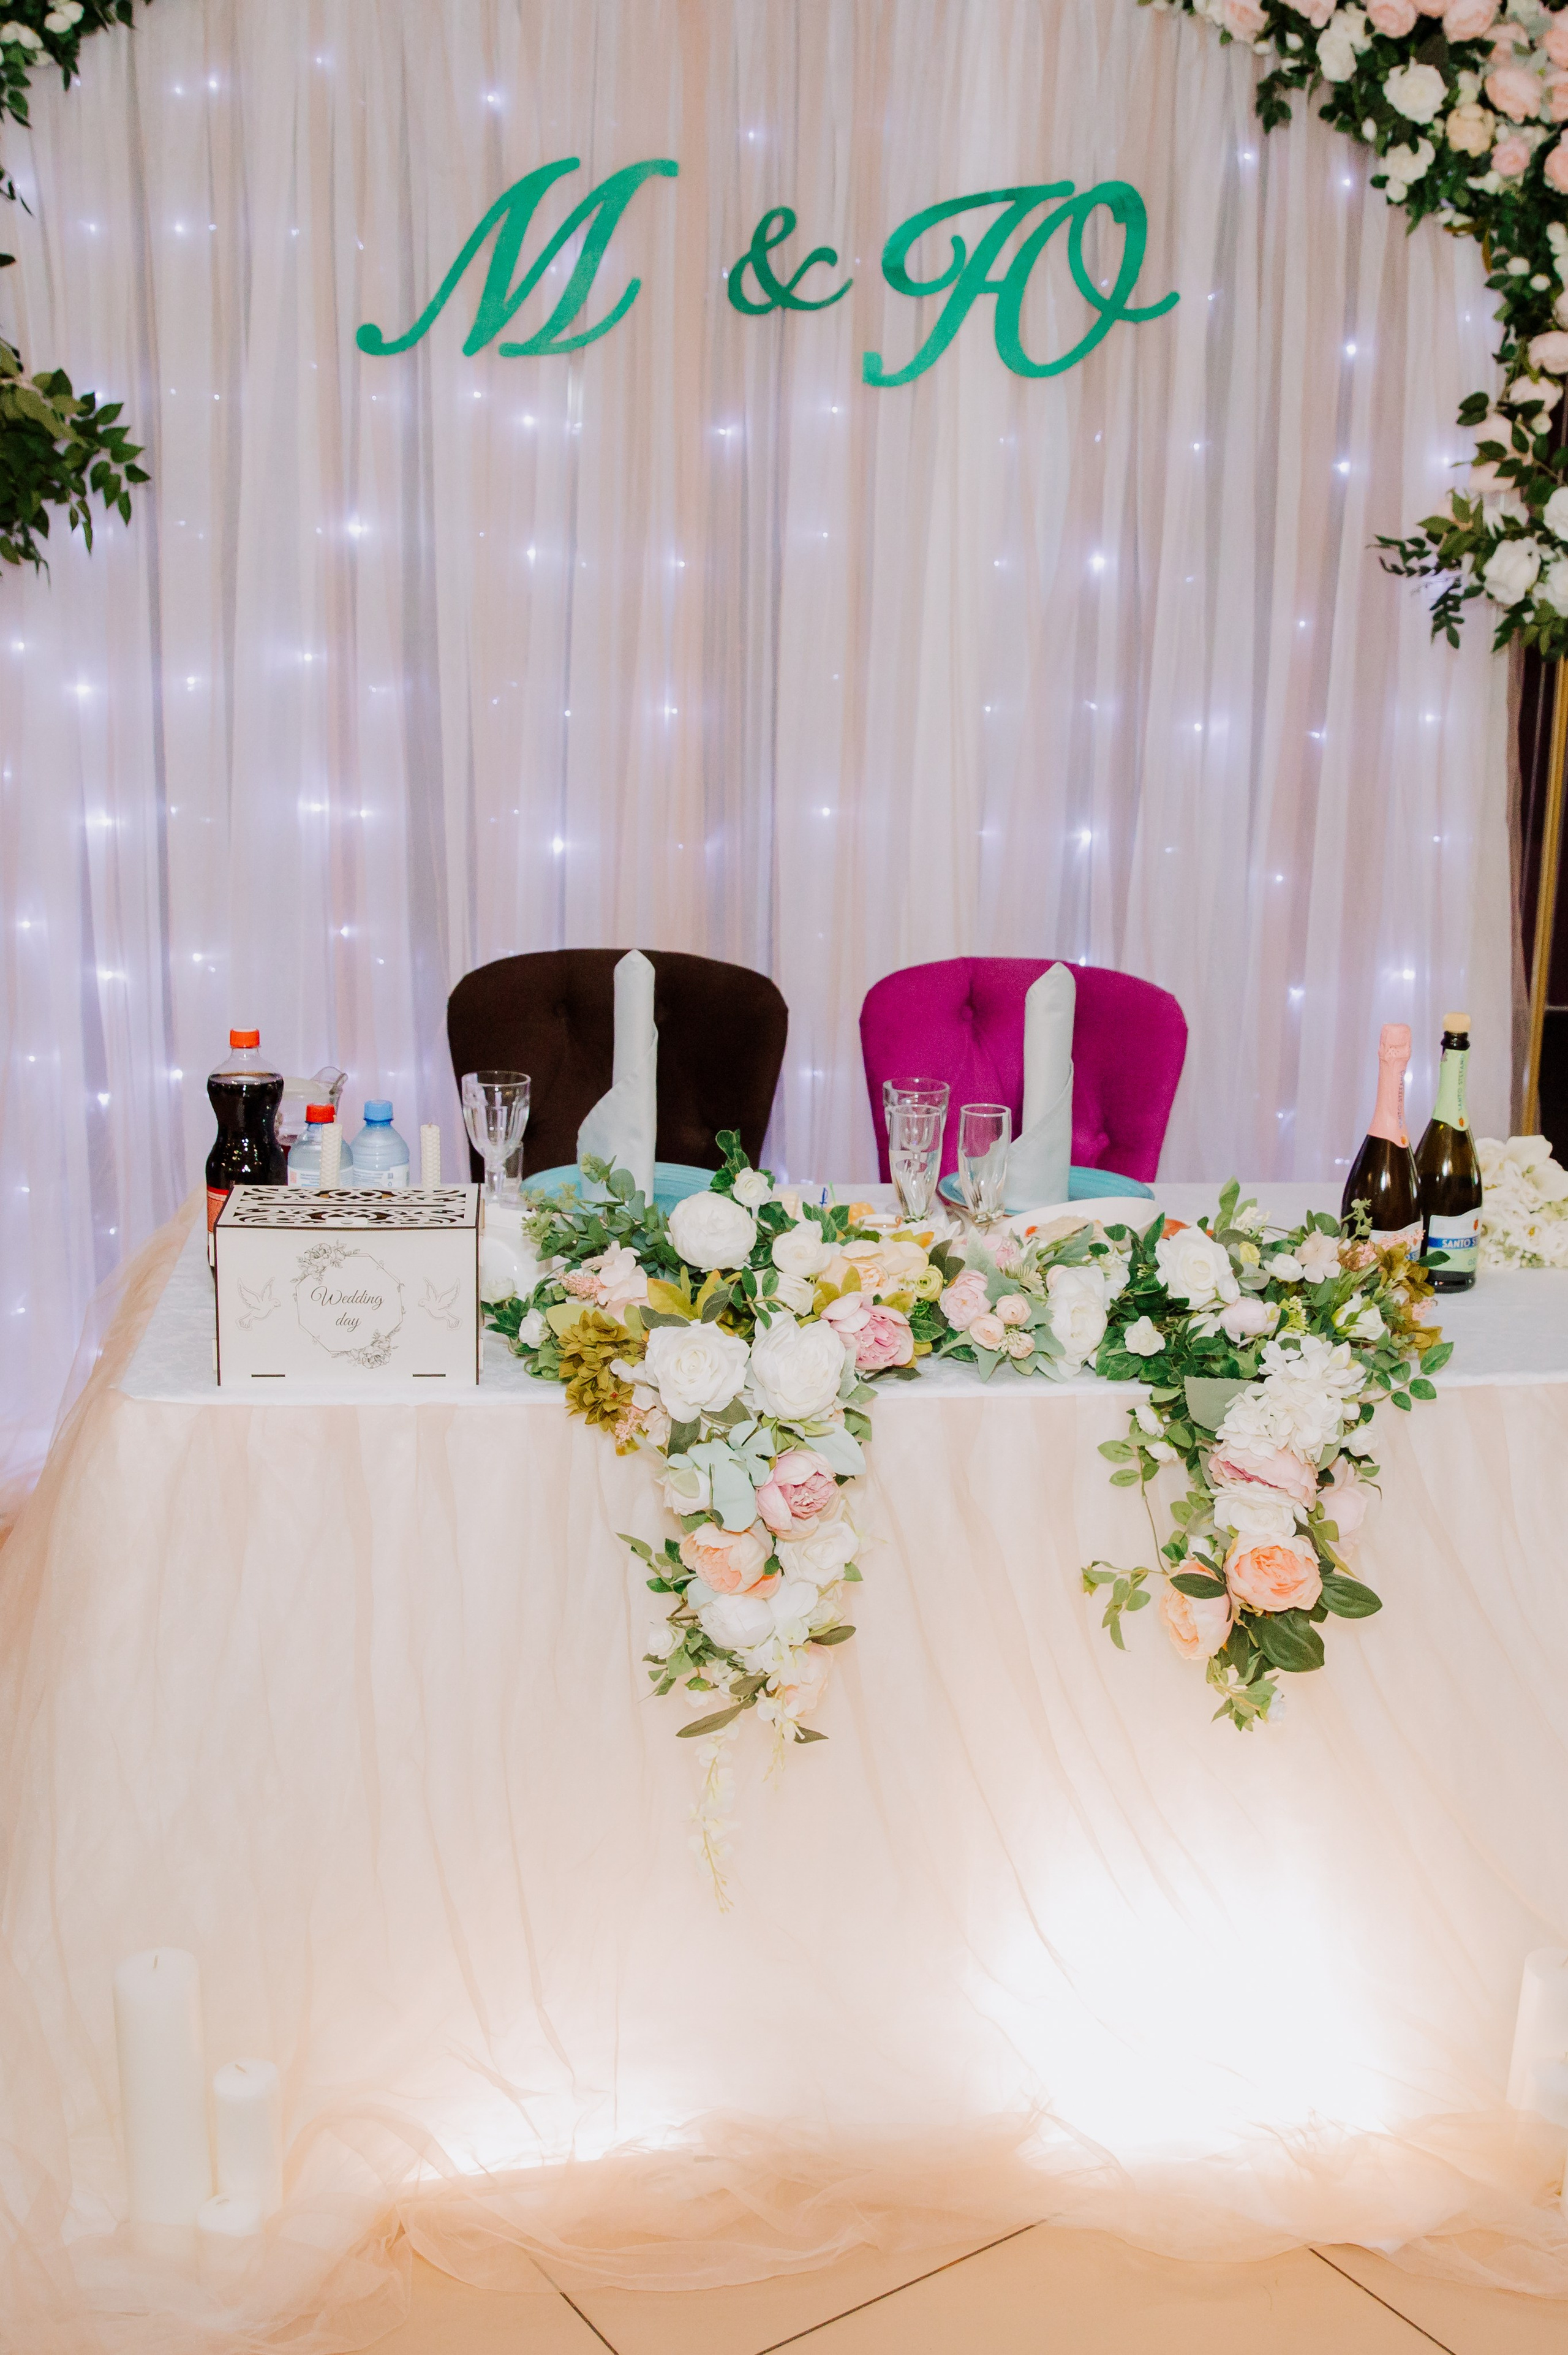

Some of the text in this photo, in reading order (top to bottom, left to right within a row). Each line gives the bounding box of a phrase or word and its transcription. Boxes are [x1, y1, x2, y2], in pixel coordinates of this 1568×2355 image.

[727, 206, 853, 315] &
[862, 180, 1180, 387] Ю
[1442, 1238, 1471, 1248] SANTO
[311, 1285, 384, 1310] Wedding
[335, 1312, 361, 1332] day
